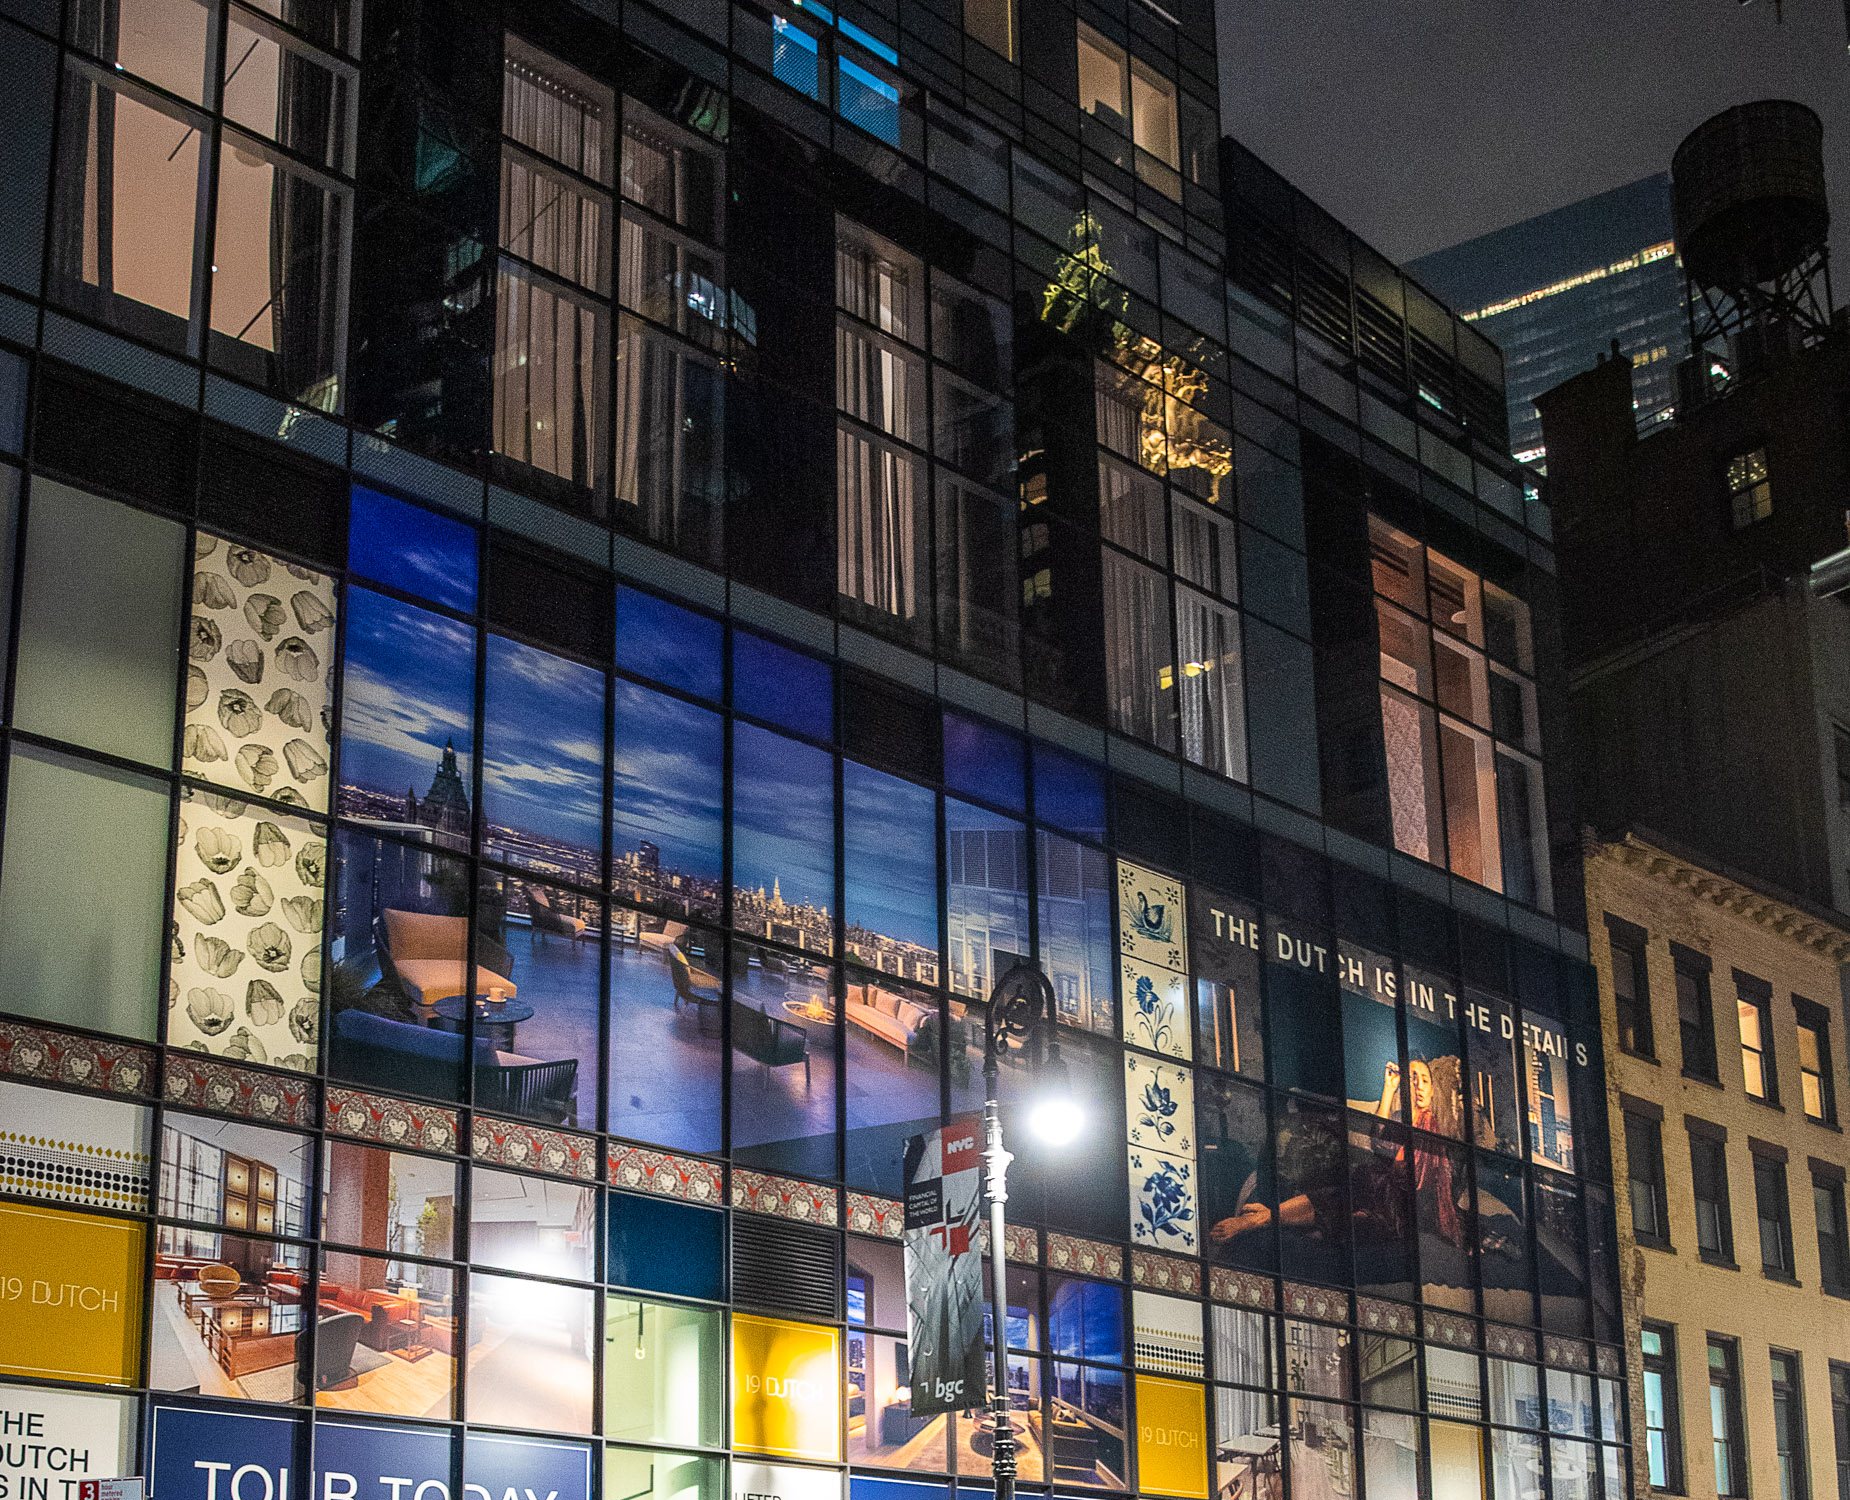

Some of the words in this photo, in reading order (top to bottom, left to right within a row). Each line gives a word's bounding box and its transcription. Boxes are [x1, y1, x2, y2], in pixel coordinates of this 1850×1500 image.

[1210, 908, 1260, 951] THE
[1375, 966, 1397, 999] IS
[1410, 980, 1435, 1012] IN
[1444, 993, 1491, 1033] THE
[946, 1136, 974, 1155] NYC
[32, 1280, 118, 1313] DUTCH
[745, 1374, 761, 1394] 19
[935, 1376, 964, 1403] bgc
[0, 1409, 45, 1437] HE
[1140, 1426, 1153, 1443] 19
[1156, 1428, 1199, 1449] DUTCH
[20, 1476, 48, 1500] IN
